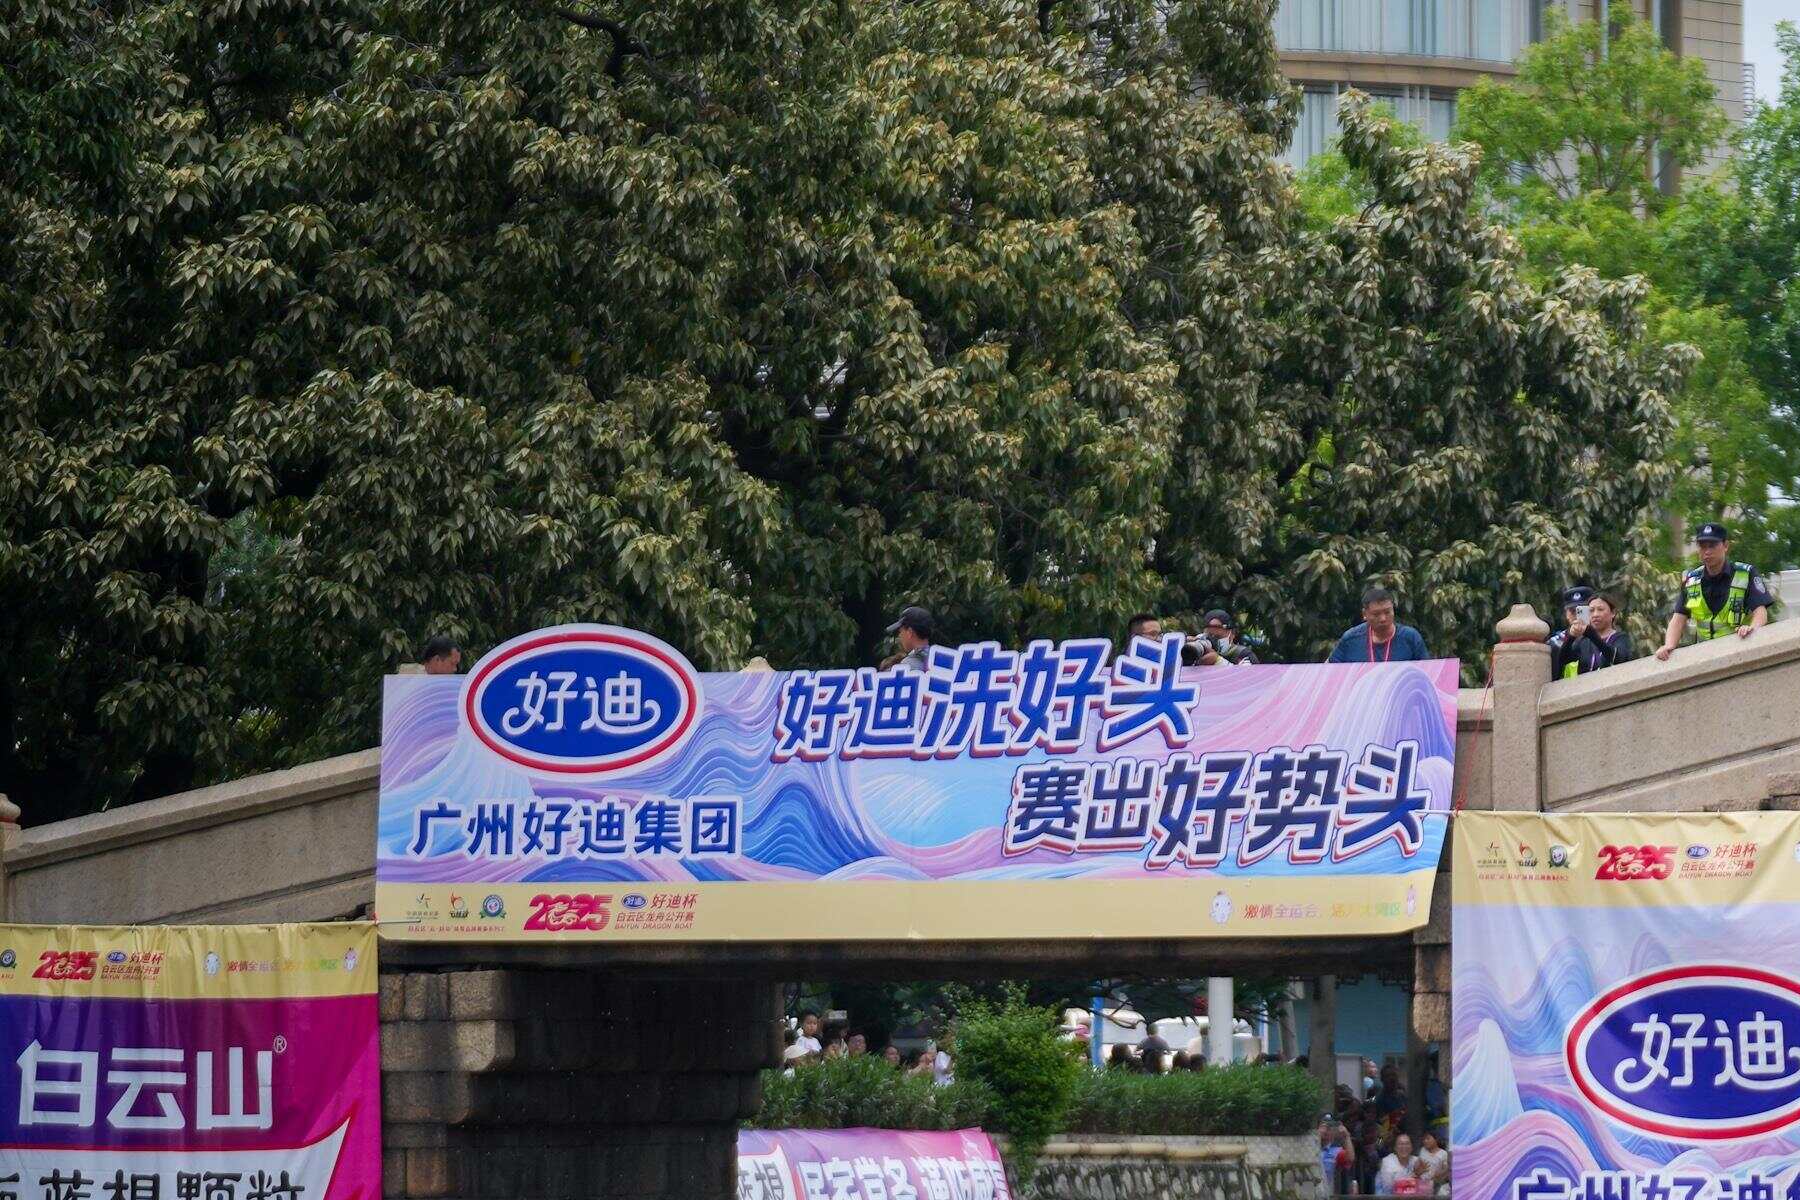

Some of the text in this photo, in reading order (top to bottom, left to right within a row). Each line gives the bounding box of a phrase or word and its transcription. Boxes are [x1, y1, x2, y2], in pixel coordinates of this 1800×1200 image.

[503, 670, 660, 736] 好迪
[778, 635, 1198, 752] 好迪洗好头
[412, 801, 738, 857] 广州好迪集团
[1011, 743, 1433, 862] 赛出好势头
[1715, 841, 1757, 858] 好迪杯
[616, 911, 695, 922] 白云区龙舟公开赛
[650, 893, 698, 908] 好迪杯
